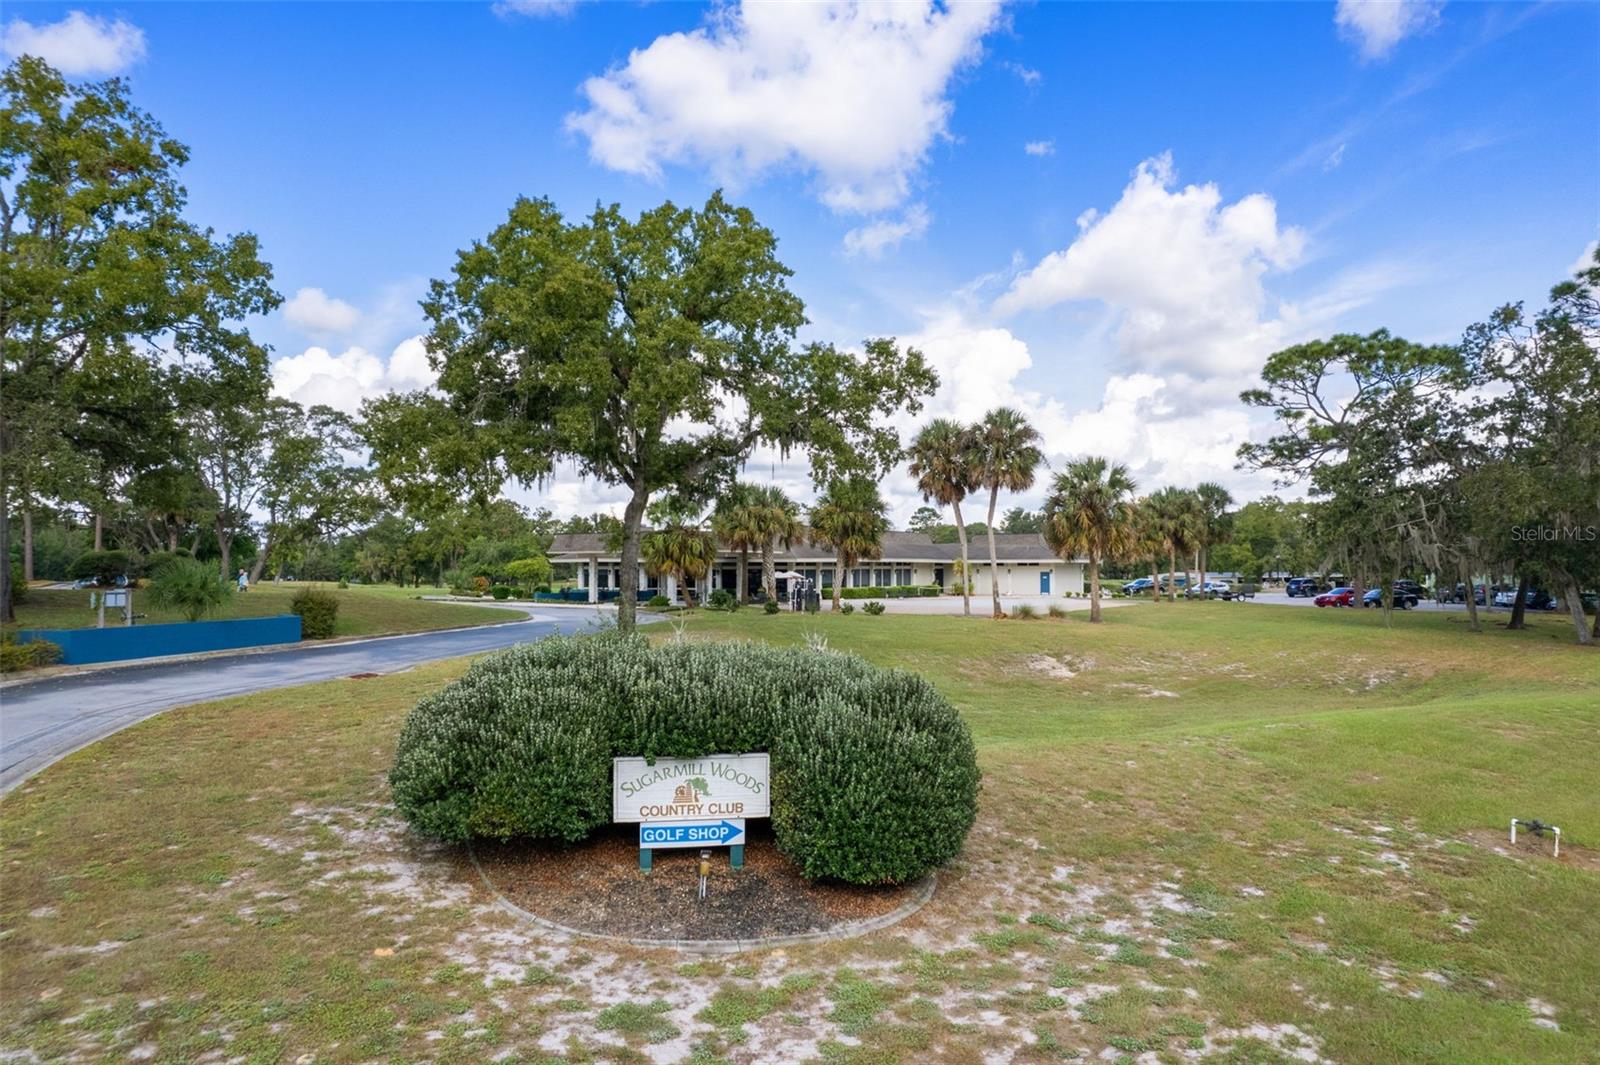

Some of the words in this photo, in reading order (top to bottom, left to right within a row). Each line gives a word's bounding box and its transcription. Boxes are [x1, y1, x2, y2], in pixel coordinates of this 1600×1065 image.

[620, 762, 706, 799] SUGARMILL
[711, 761, 765, 794] WOODS
[639, 803, 704, 817] COUNTRY
[708, 802, 744, 814] CLUB
[643, 828, 685, 842] GOLF
[688, 827, 729, 840] SHOP
